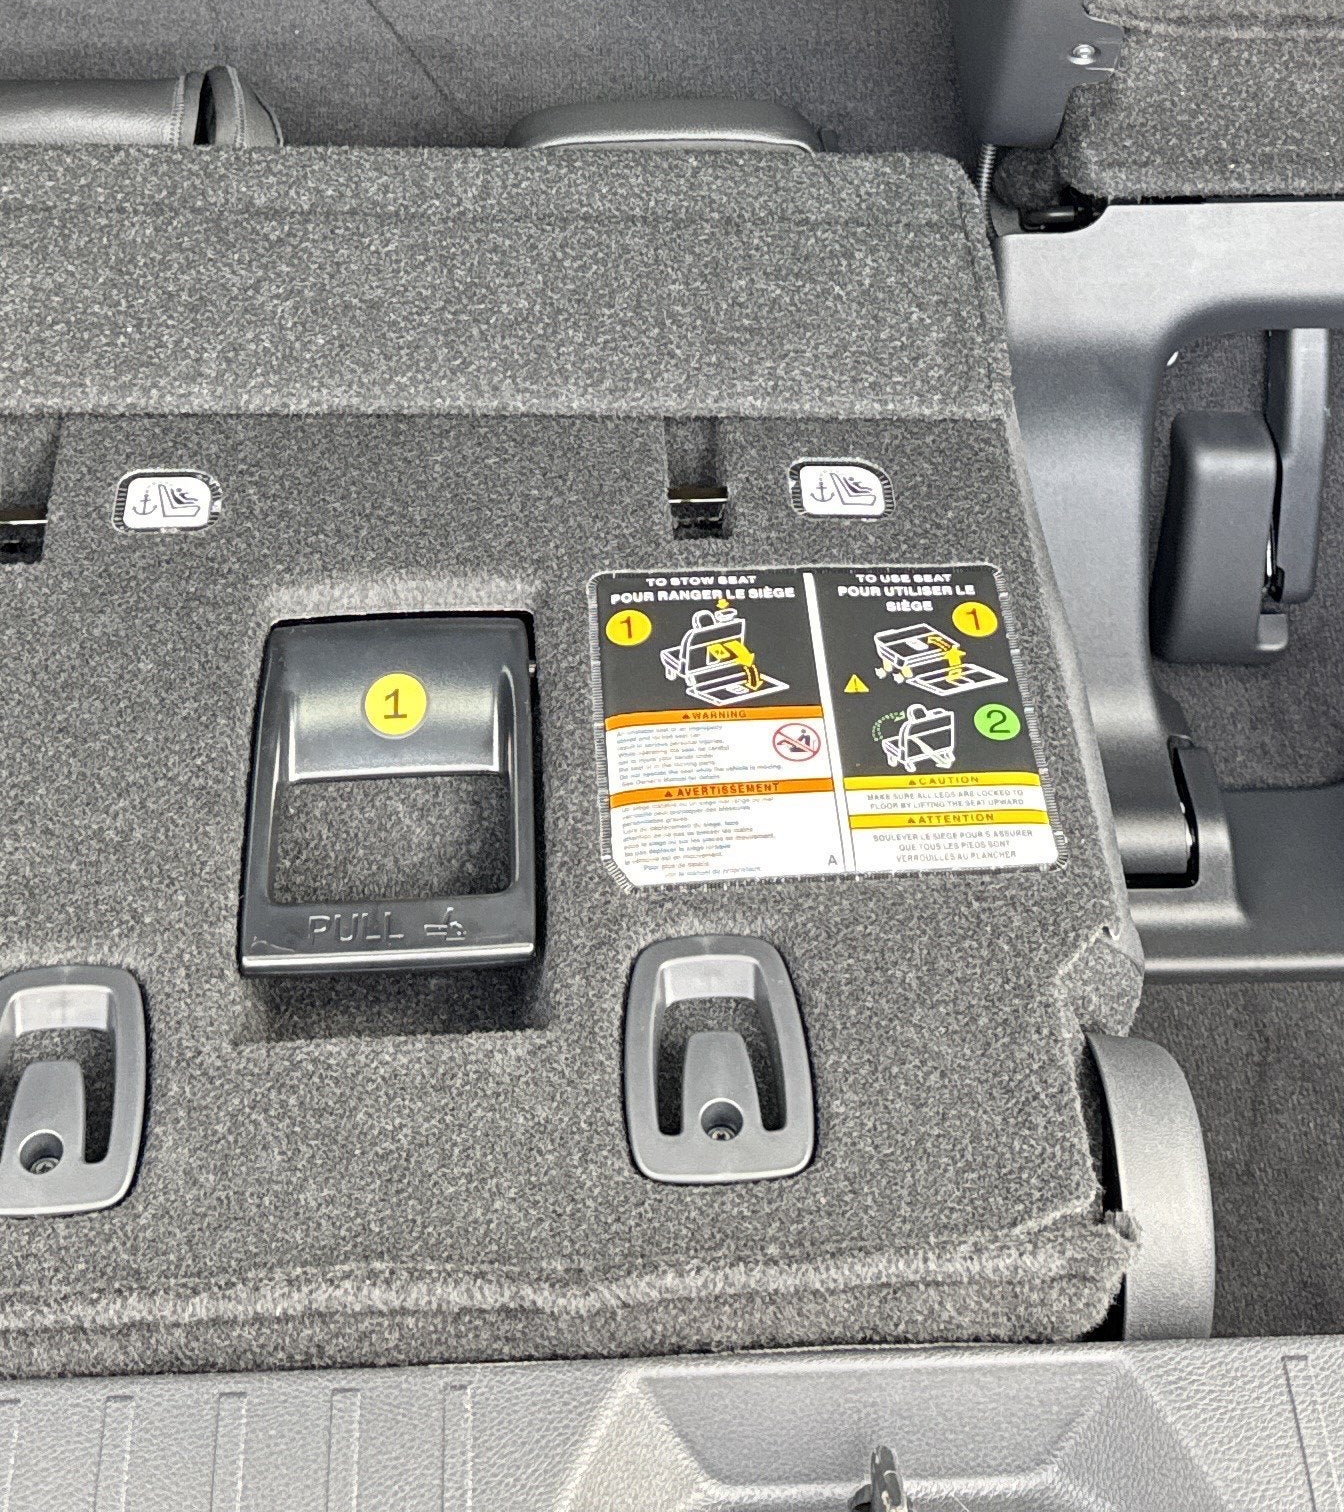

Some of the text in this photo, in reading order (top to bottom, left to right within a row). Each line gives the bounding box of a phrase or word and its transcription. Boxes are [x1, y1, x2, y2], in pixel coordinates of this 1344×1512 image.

[646, 575, 758, 587] TO STOW SEAT
[855, 573, 952, 583] TO USE SEAT
[611, 585, 795, 605] POUR RANGER LE SIÈGE
[837, 584, 976, 597] POUR UTILISER LE
[885, 598, 934, 612] SIÈGE
[966, 608, 980, 631] 1
[618, 615, 635, 640] 1
[383, 688, 408, 720] 1
[691, 709, 747, 719] WARNING
[986, 710, 1011, 735] 2
[917, 775, 979, 785] CAUTION
[676, 782, 780, 798] AVERTISSEMENT
[918, 813, 995, 823] ATTENTION
[828, 854, 838, 866] A
[309, 911, 404, 944] PULL
